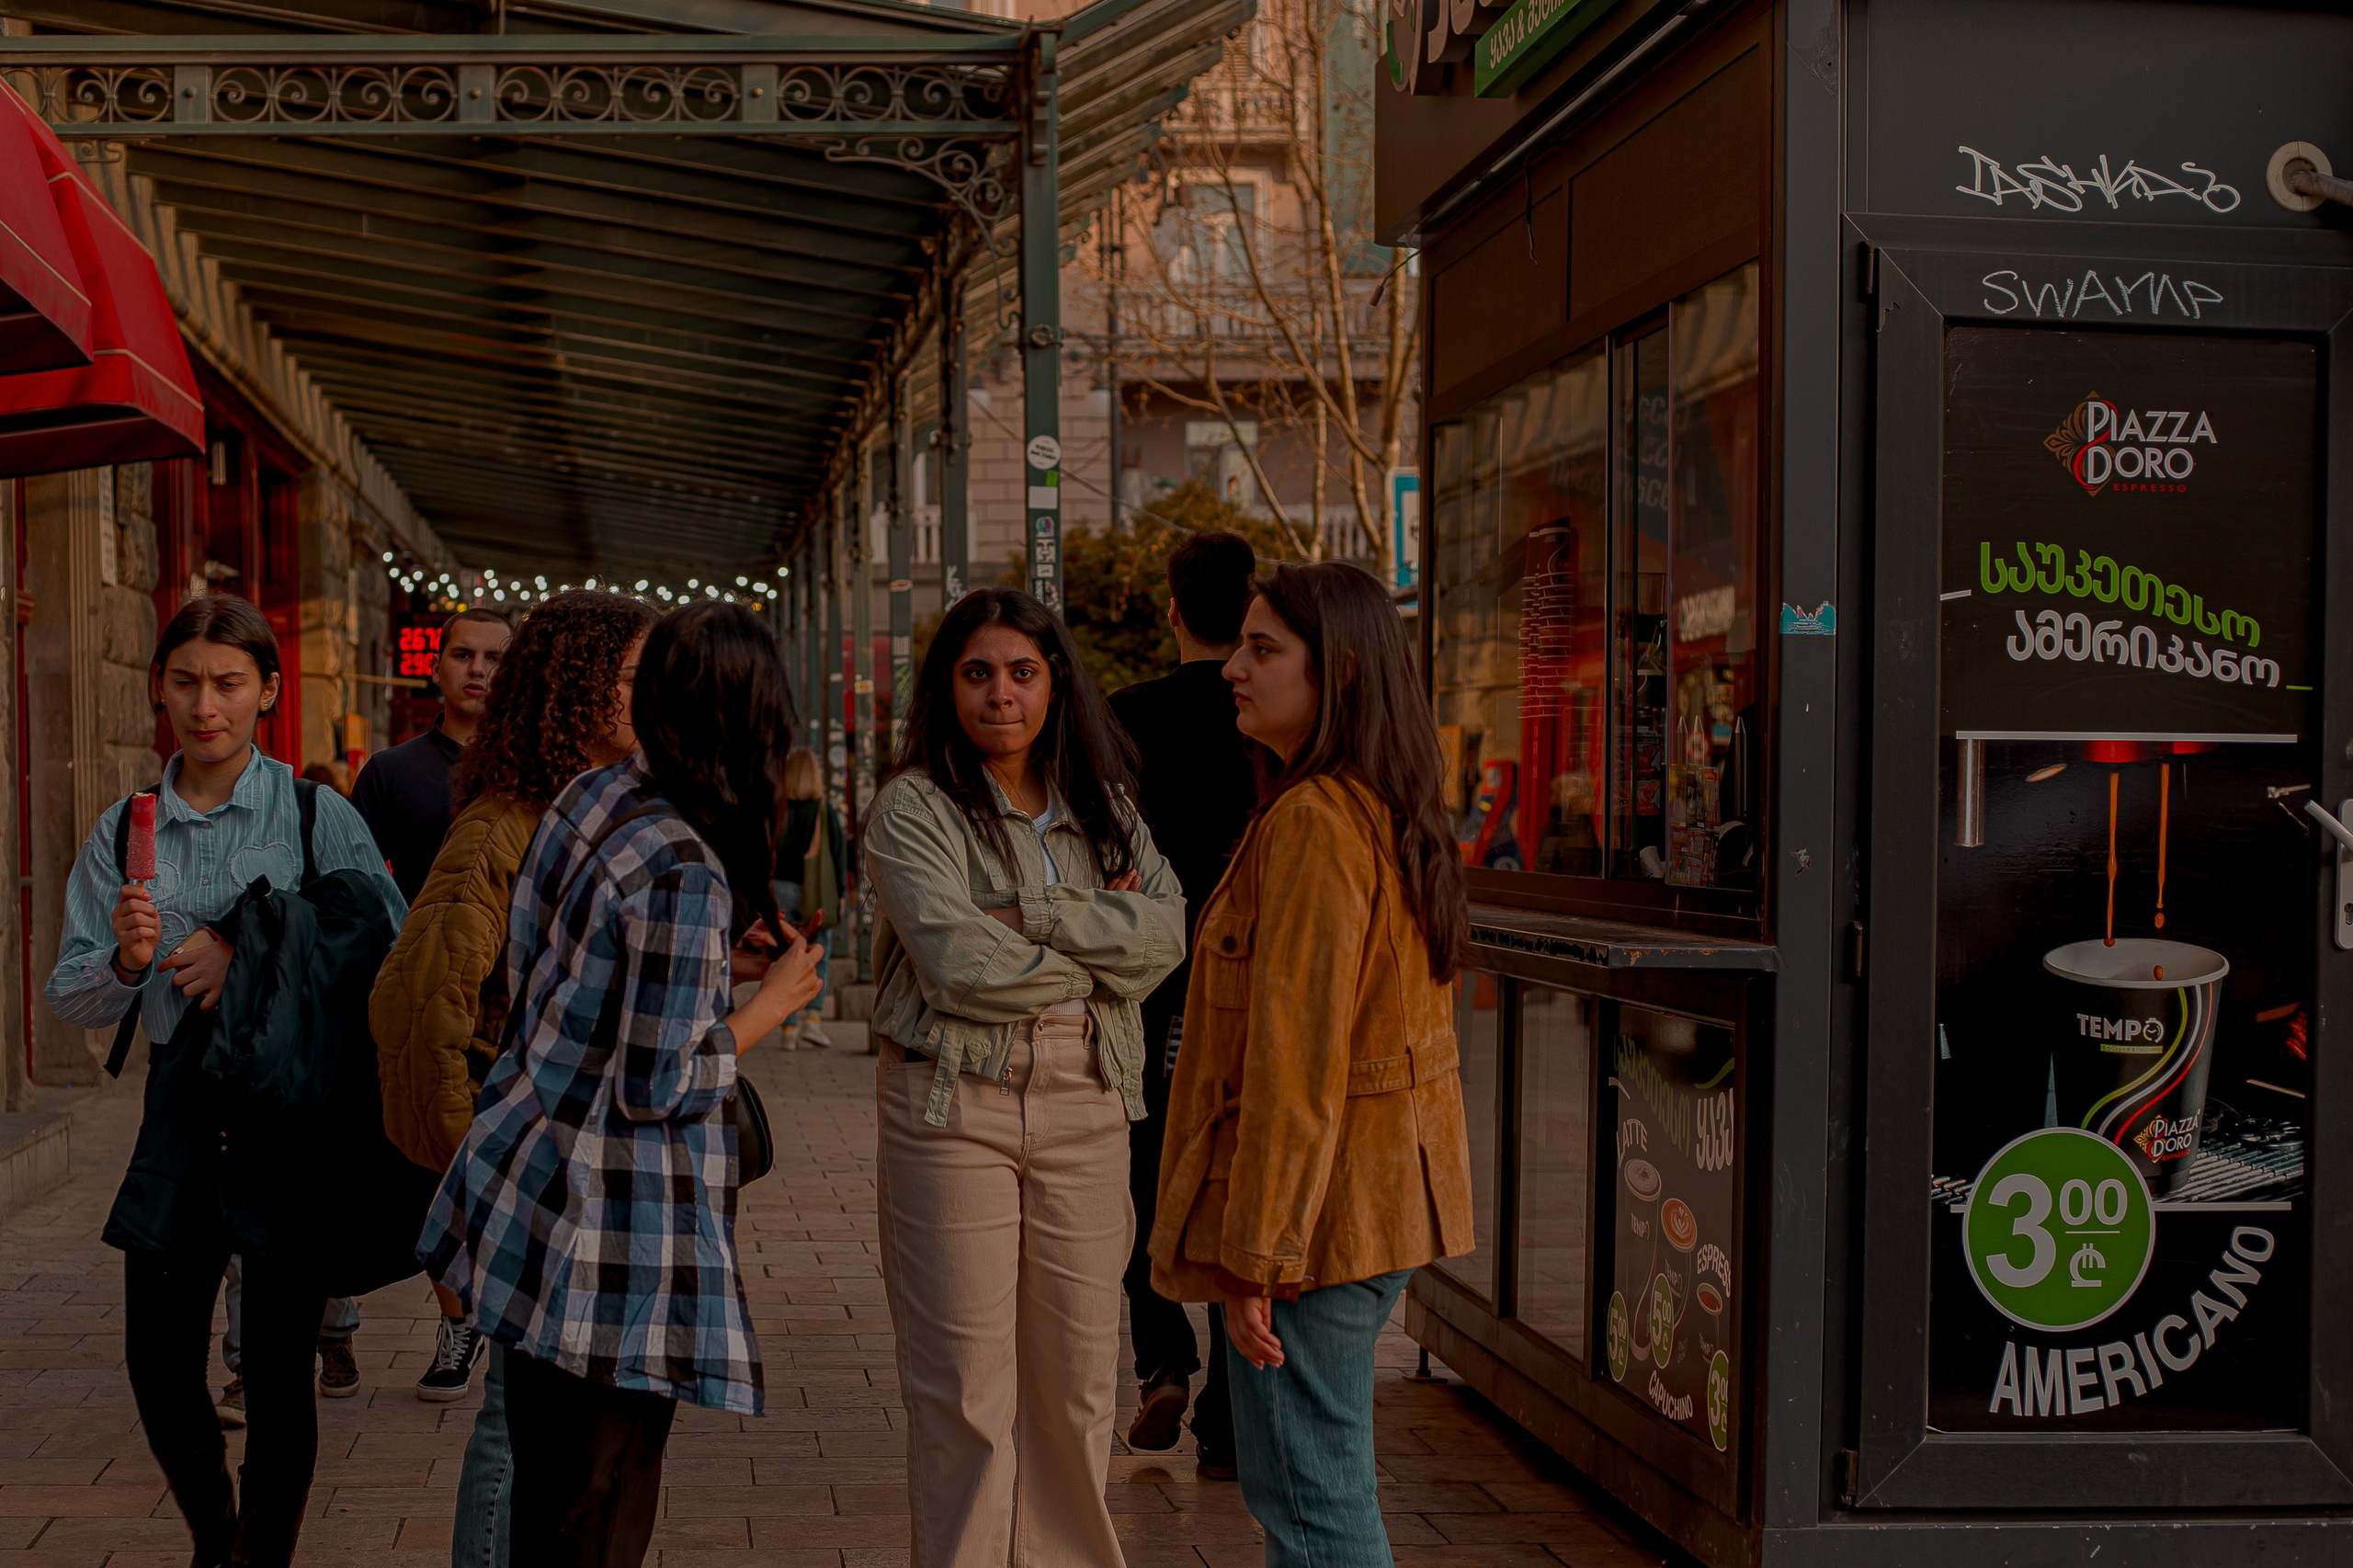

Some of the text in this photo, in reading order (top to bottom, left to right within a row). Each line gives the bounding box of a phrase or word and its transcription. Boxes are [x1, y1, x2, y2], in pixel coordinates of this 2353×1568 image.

[1490, 17, 1515, 70] ყავა
[1517, 8, 1525, 44] &
[1983, 269, 2223, 320] SWAMP
[2086, 401, 2219, 445] PIAZZA
[2086, 445, 2195, 485] DORO
[2112, 483, 2188, 494] ESPRESSO
[1980, 540, 2261, 648] საუკეთესო
[2006, 608, 2281, 688] ამერიკანო
[2075, 1012, 2165, 1044] TEMPO
[1615, 1118, 1648, 1169] LATTE
[2154, 1113, 2199, 1139] PIAZZA
[1988, 1224, 2276, 1418] AMERICANO
[1648, 1369, 1694, 1421] CAPUCHINO
